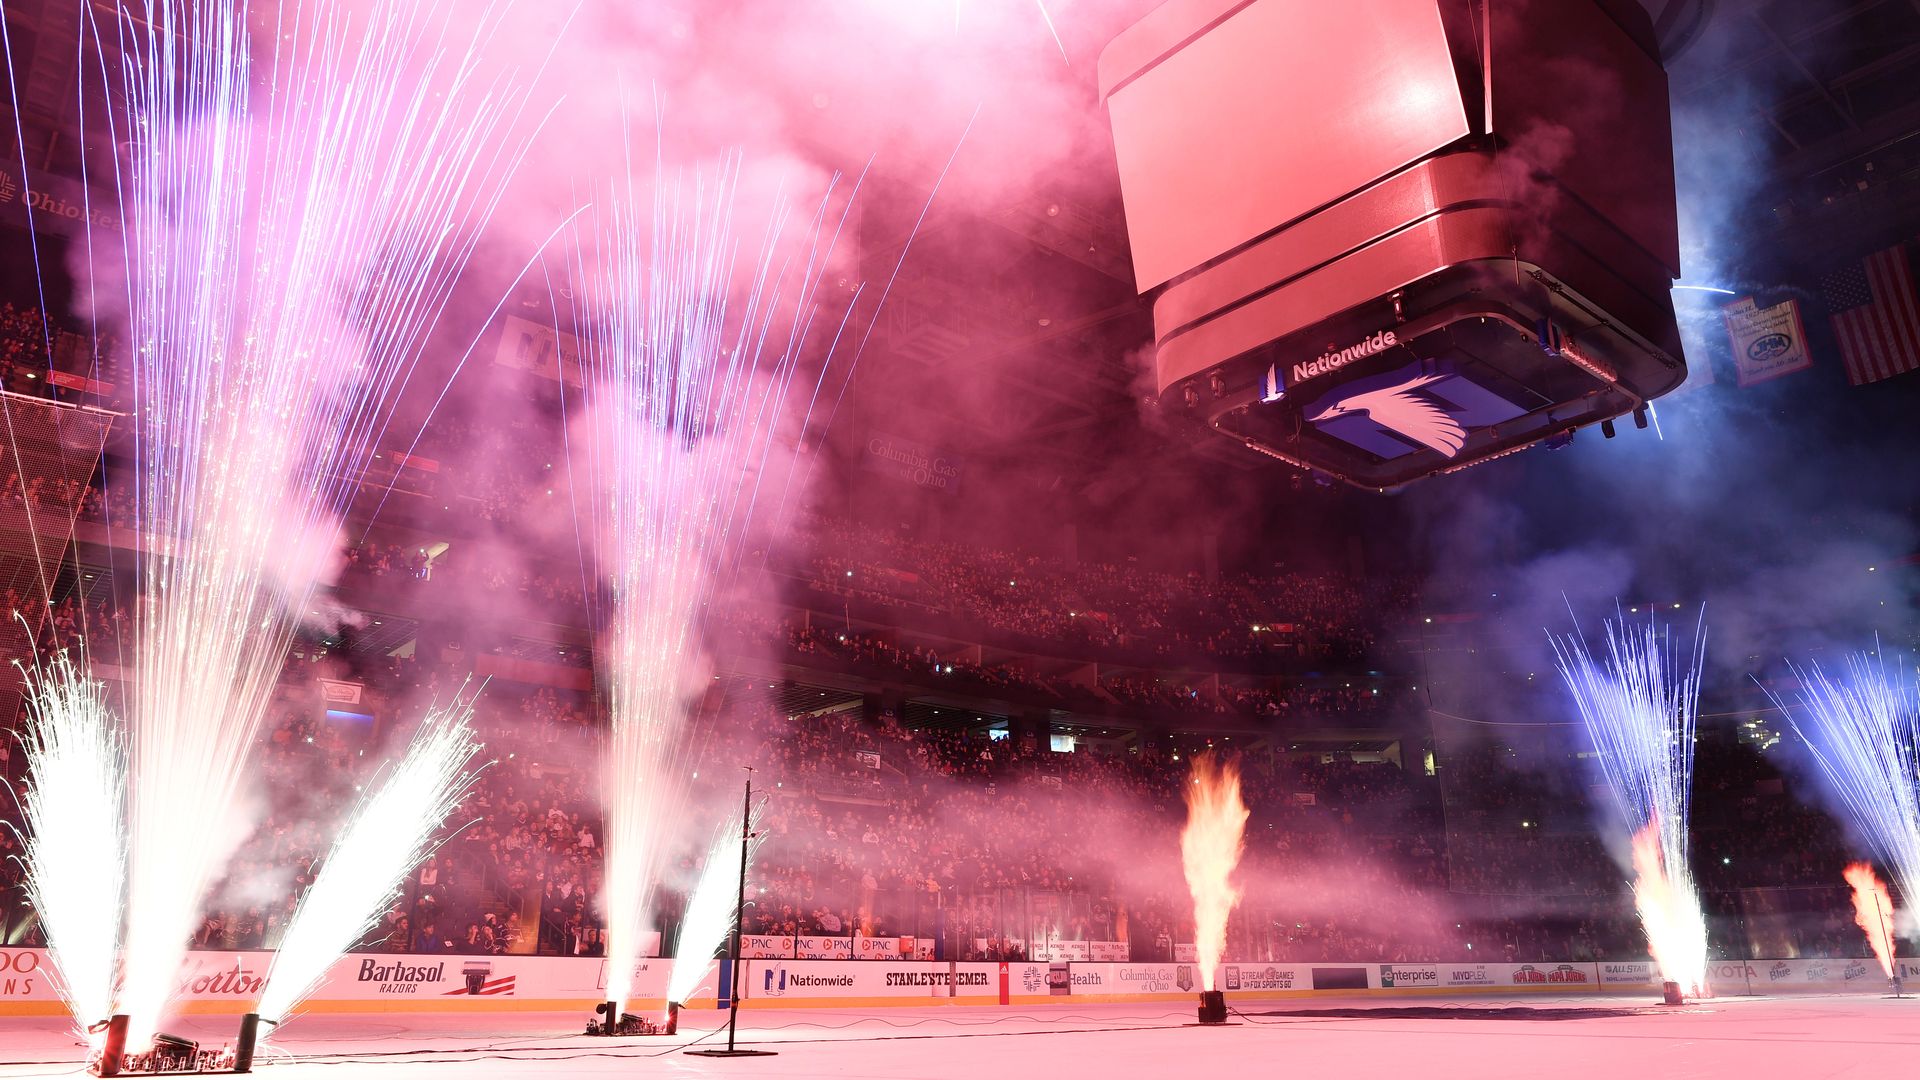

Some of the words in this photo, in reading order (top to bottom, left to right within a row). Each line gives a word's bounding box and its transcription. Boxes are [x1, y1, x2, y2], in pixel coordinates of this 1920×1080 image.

[1293, 331, 1397, 381] Nationwide
[869, 439, 928, 469] Columbia
[934, 457, 958, 477] Gas
[900, 467, 911, 479] of
[914, 467, 946, 488] Ohio
[872, 940, 890, 950] PNC
[358, 959, 443, 982] Barbasol
[1120, 969, 1157, 981] Columbia
[1158, 969, 1173, 981] Gas
[1384, 969, 1436, 983] enterprise
[1453, 971, 1487, 980] MYOPLEX
[1769, 967, 1791, 981] Blue
[1844, 967, 1866, 980] Blue
[790, 974, 853, 986] Nationwide
[1141, 981, 1149, 991] of
[1150, 982, 1169, 992] Ohio
[380, 984, 417, 993] RAZORS
